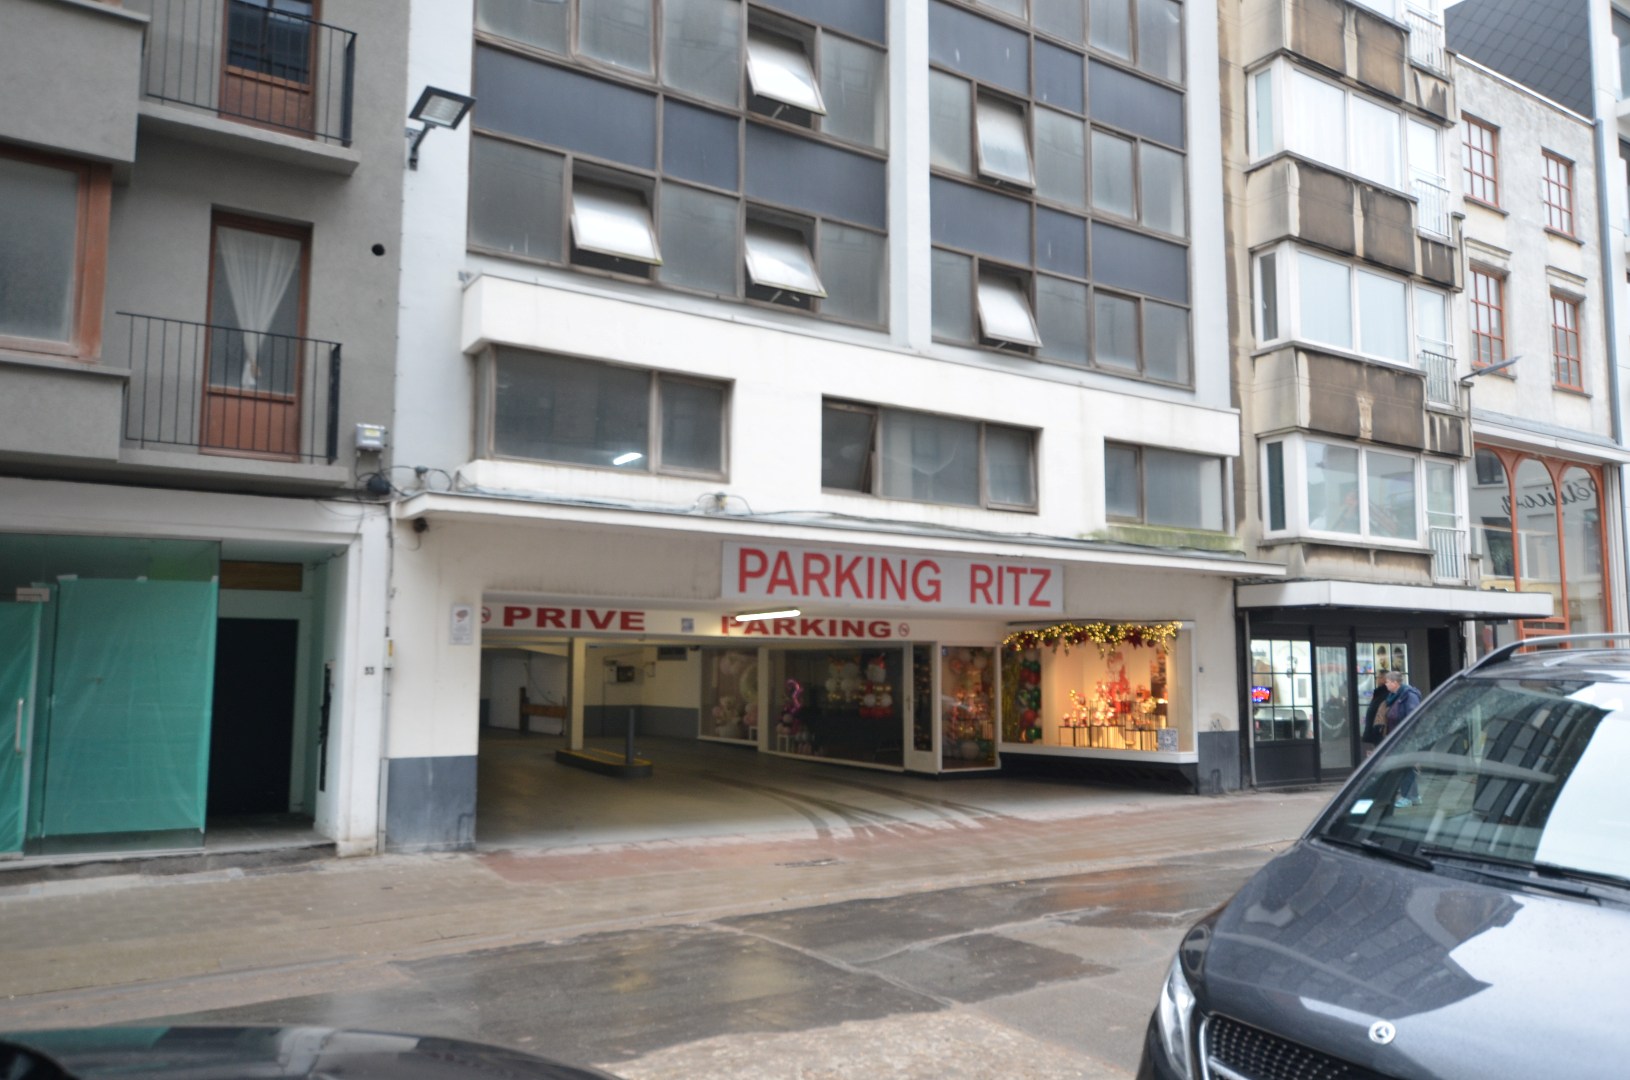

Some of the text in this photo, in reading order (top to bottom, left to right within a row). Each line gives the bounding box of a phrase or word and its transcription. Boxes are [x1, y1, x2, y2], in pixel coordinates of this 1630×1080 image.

[738, 547, 1052, 608] PARKING RITZ
[503, 606, 645, 631] PRIVE
[721, 615, 892, 639] PARKING
